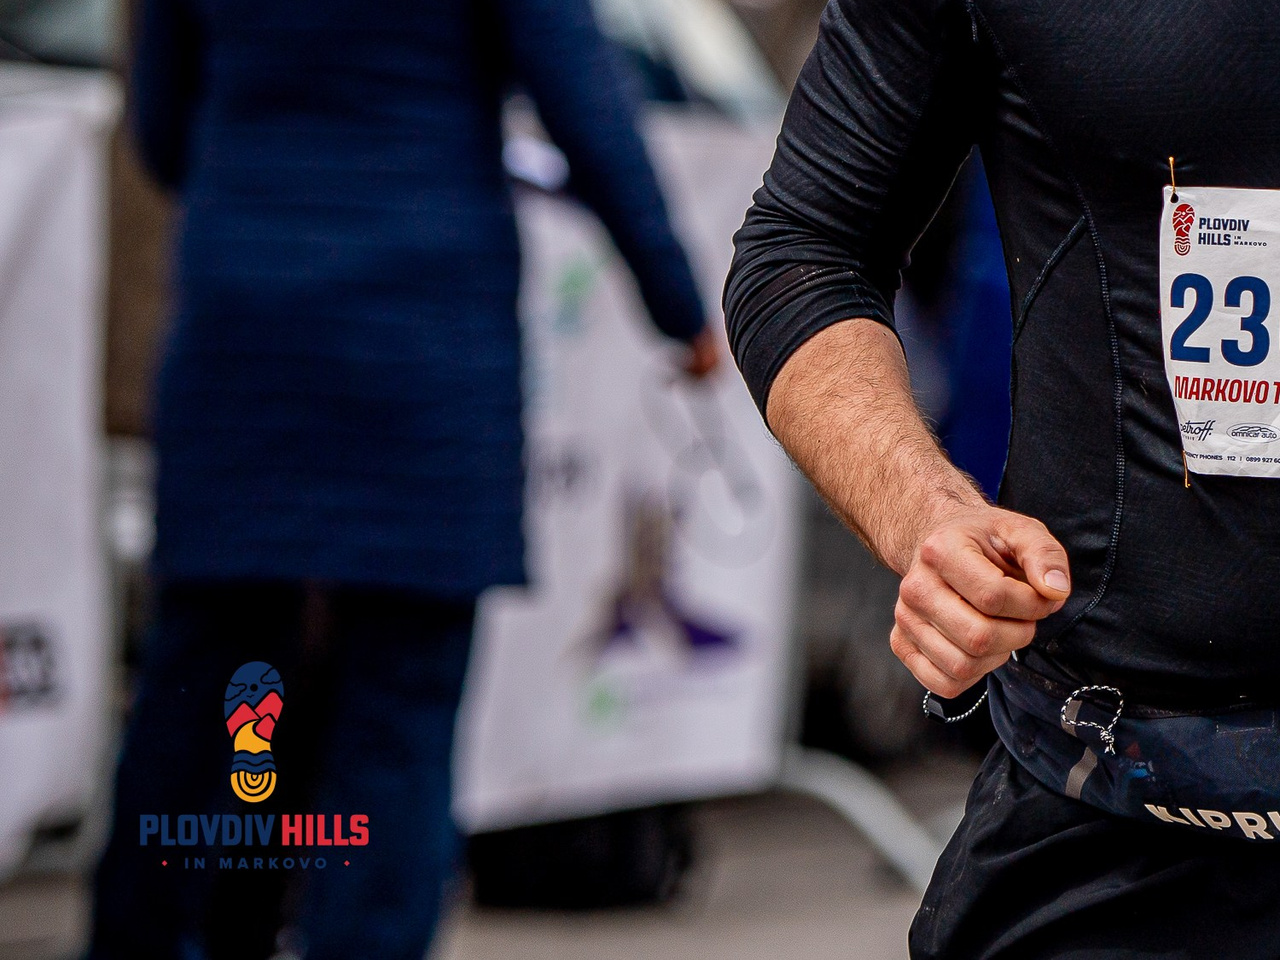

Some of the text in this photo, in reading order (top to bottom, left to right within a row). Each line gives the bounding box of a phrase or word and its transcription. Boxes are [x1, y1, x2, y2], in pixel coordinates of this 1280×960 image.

[1198, 217, 1250, 231] PLOVDIV
[1198, 232, 1231, 246] HILLS
[1174, 375, 1270, 404] MARKOVO
